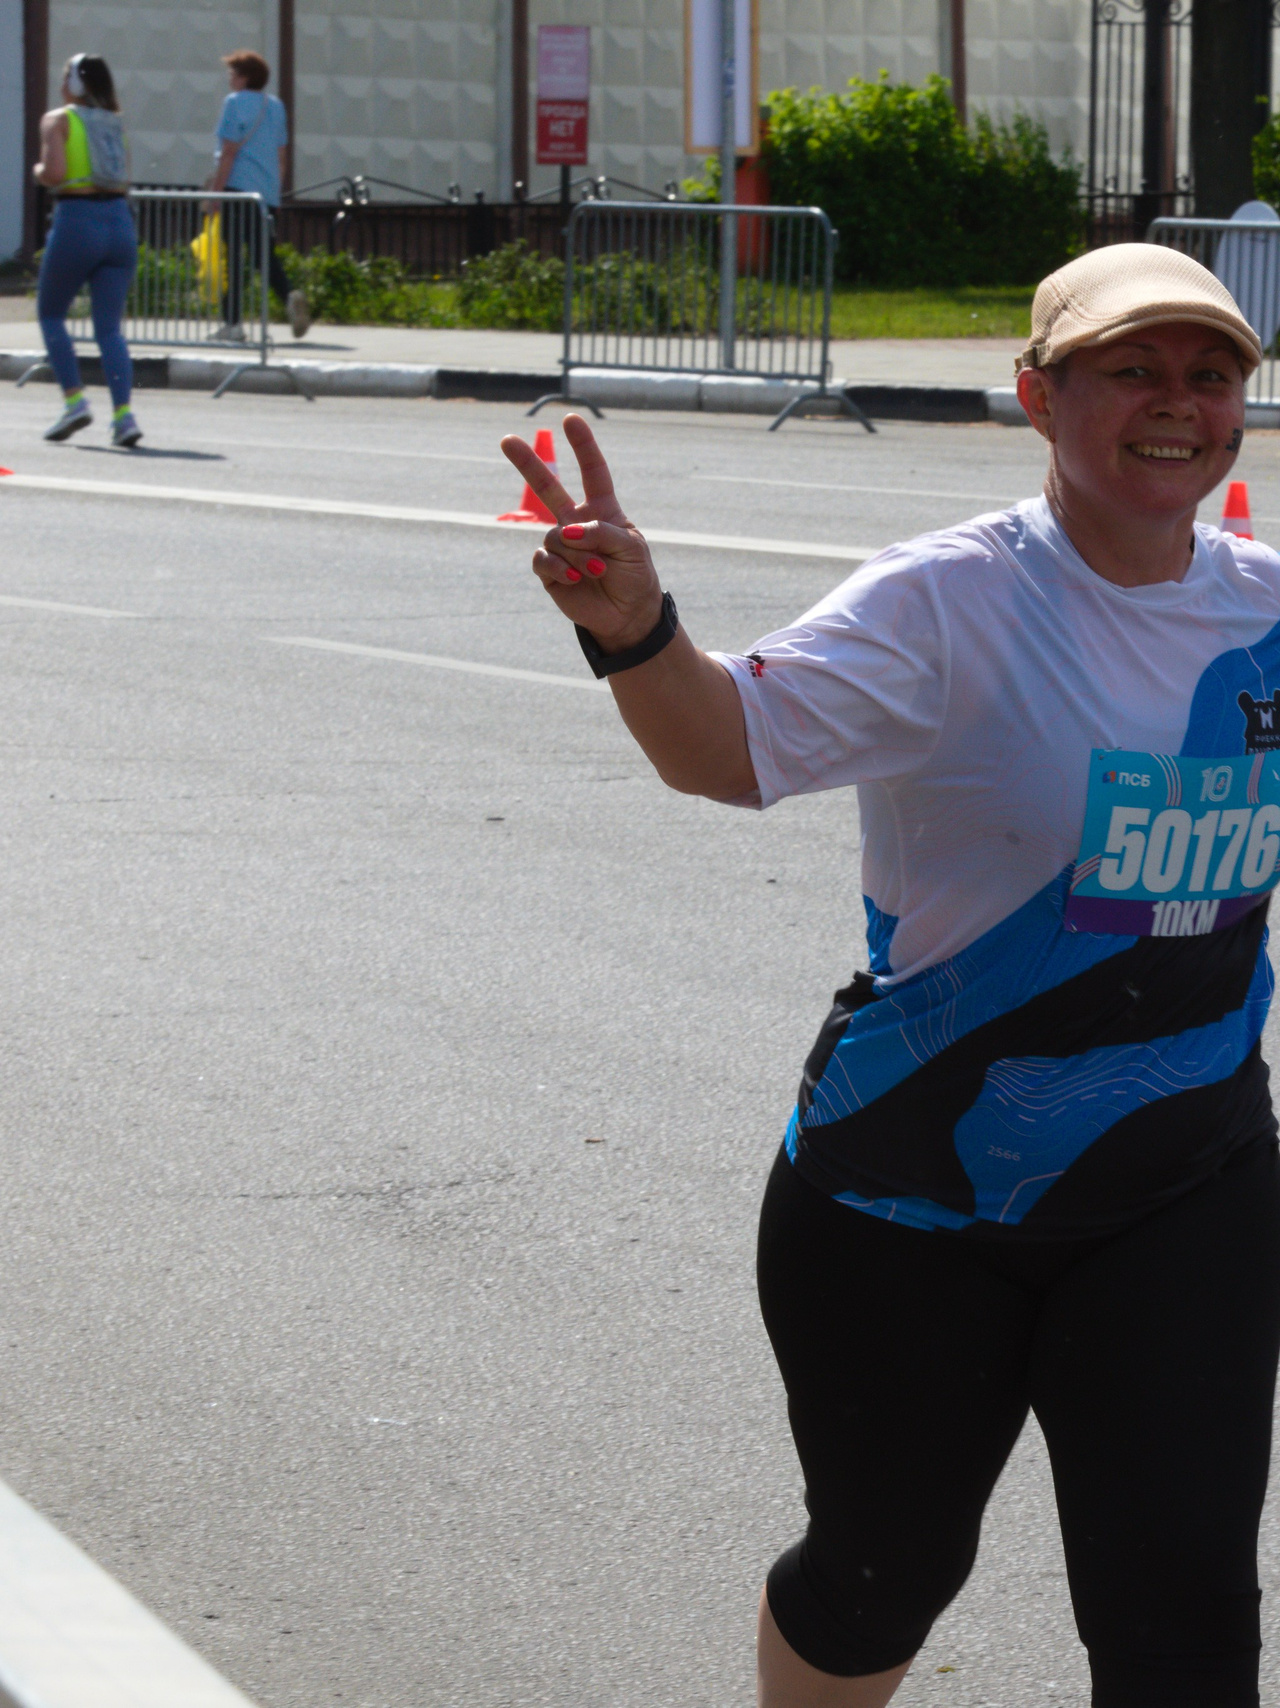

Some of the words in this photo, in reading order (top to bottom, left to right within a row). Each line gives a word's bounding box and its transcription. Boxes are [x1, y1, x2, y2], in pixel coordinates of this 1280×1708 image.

[1118, 772, 1151, 787] ПСБ
[1200, 765, 1233, 802] 10
[1151, 899, 1220, 937] 10KM
